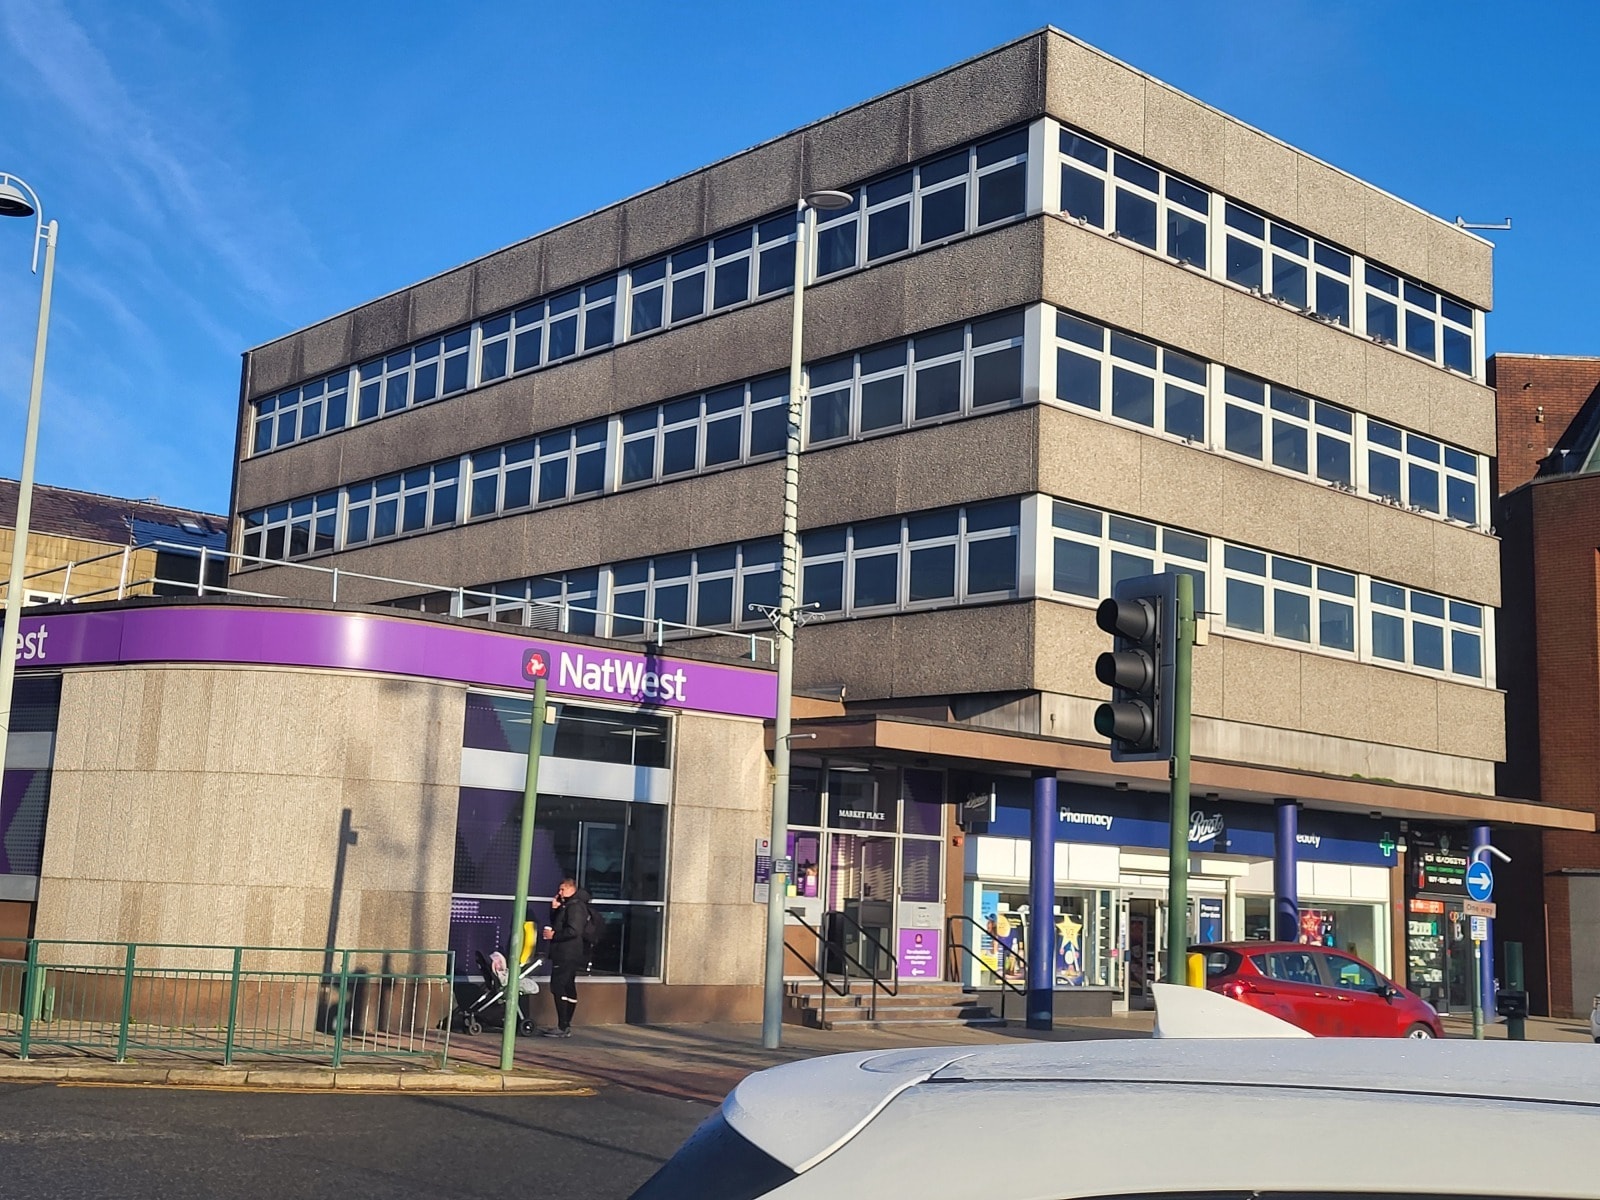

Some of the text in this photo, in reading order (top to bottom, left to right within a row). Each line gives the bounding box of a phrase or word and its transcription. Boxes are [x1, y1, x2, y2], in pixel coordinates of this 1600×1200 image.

[15, 623, 48, 660] est
[559, 651, 687, 702] NatWest
[838, 809, 885, 820] MARKET PLACE
[1060, 806, 1113, 831] Pharmacy
[1187, 810, 1224, 844] Boots
[1466, 903, 1493, 915] One way
